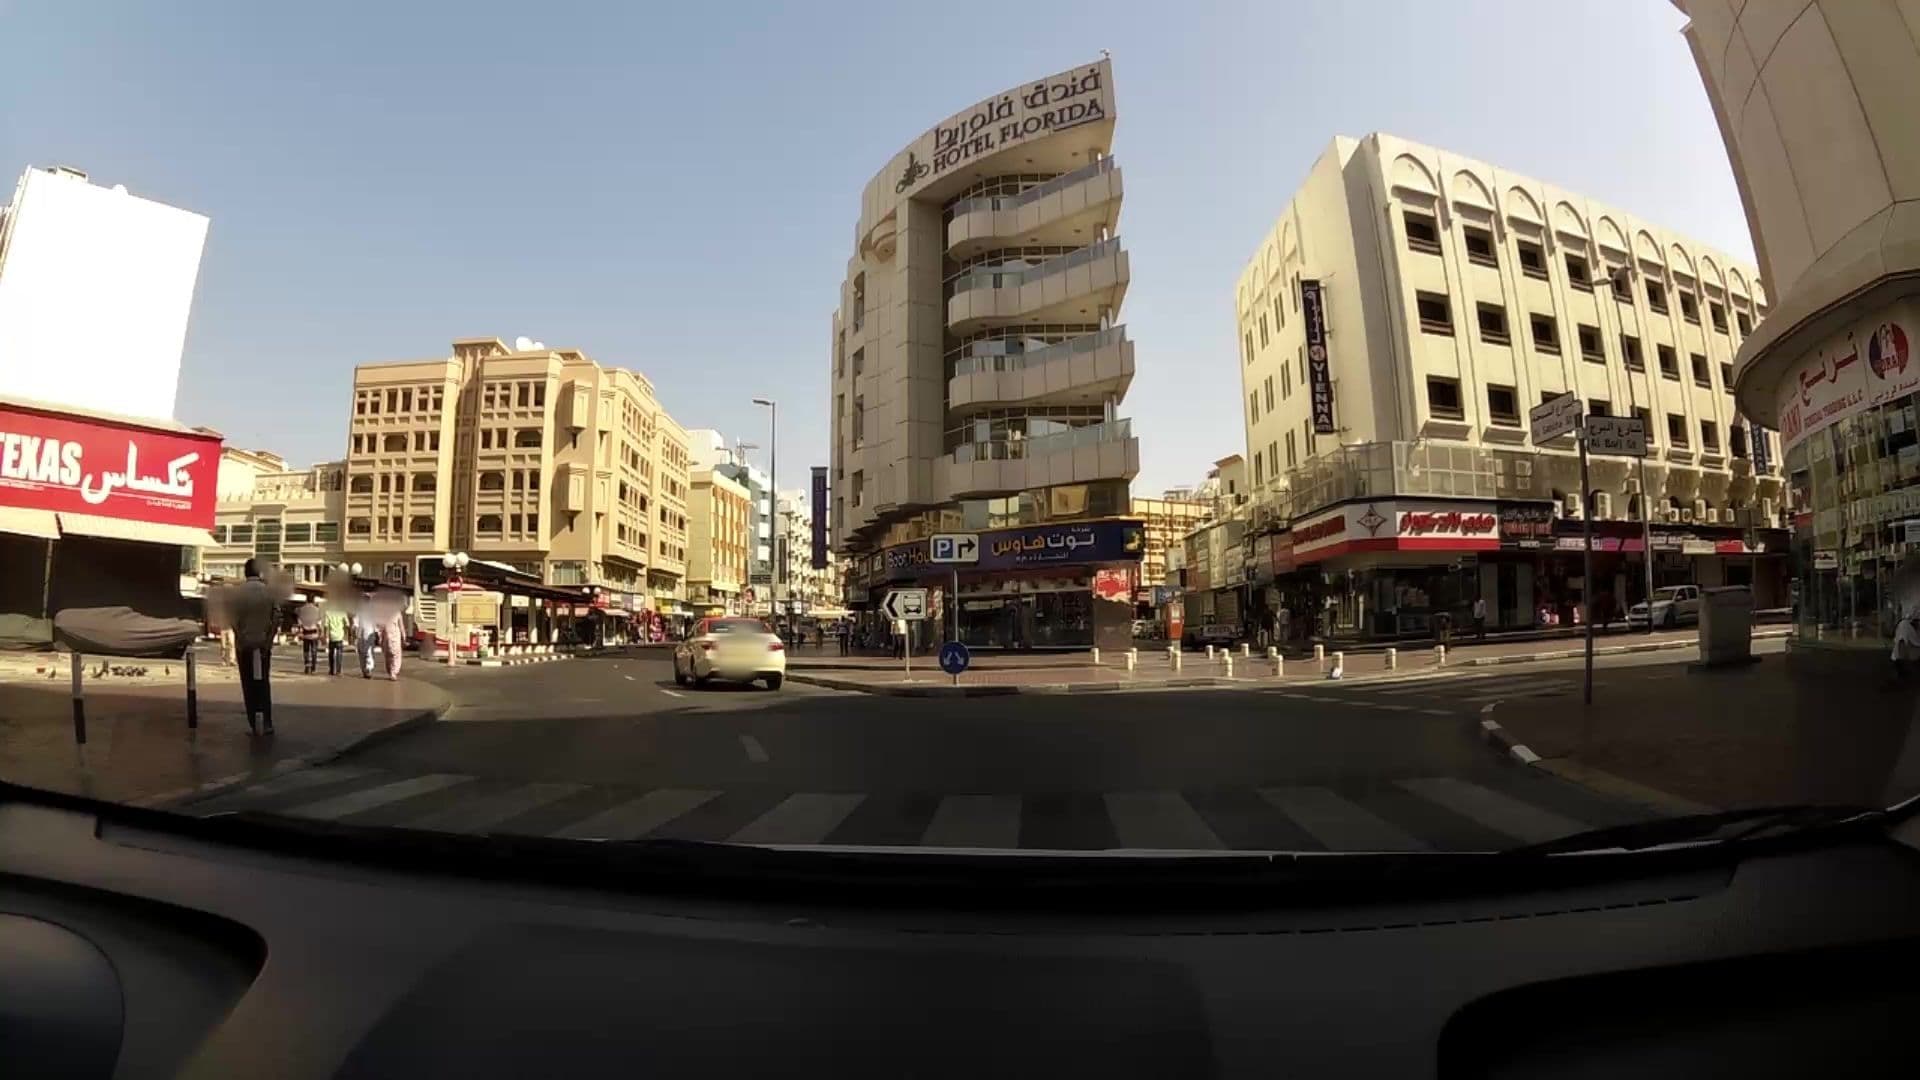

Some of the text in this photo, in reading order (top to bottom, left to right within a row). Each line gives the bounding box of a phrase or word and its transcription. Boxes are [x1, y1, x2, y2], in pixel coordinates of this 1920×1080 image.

[933, 68, 1102, 150] فندق فلوريدا
[932, 98, 1104, 174] HOTEL FLORIDA
[1311, 361, 1330, 424] VIENNA
[1617, 423, 1642, 438] شارع
[80, 439, 199, 505] تكساس
[910, 544, 930, 566] Hou
[936, 540, 950, 558] P
[991, 534, 1046, 557] هاوس
